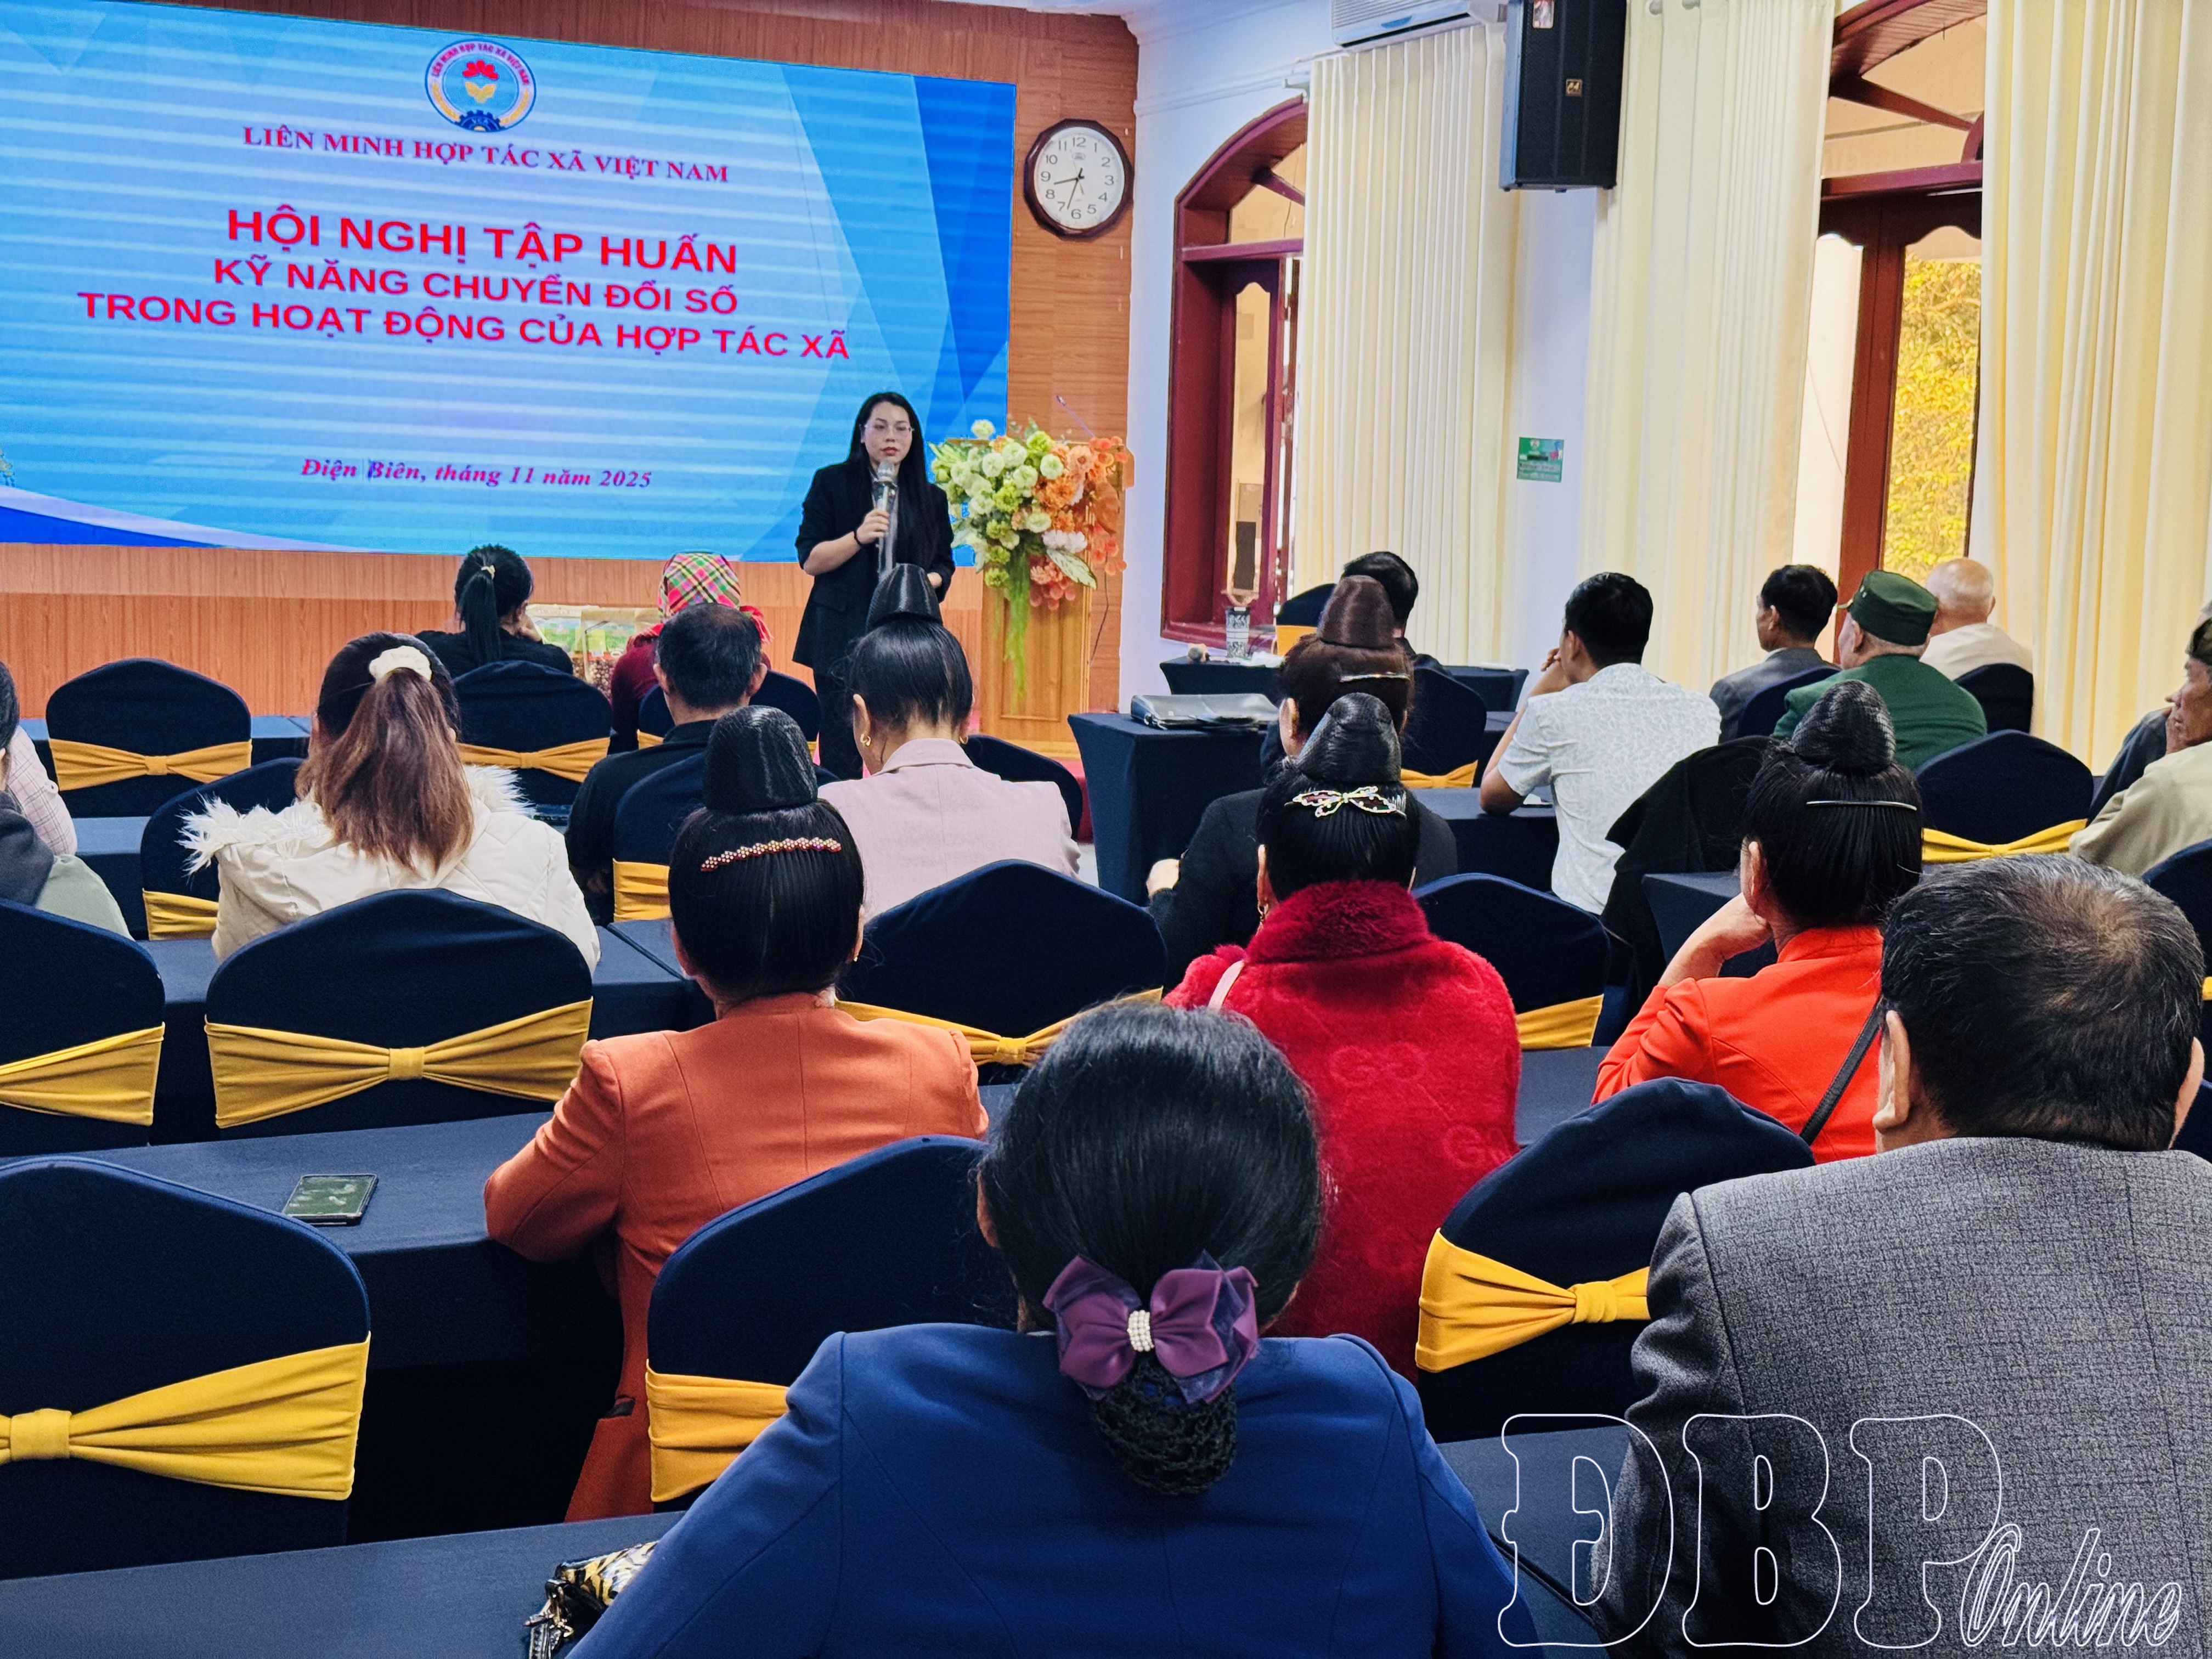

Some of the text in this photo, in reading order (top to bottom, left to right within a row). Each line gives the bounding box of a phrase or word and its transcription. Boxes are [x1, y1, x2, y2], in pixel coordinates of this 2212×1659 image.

[1058, 140, 1067, 151] 11
[1073, 137, 1086, 148] 12
[1094, 143, 1098, 153] 1
[243, 125, 729, 183] LIÊN MINH HỢP TÁC XÃ VIỆT NAM
[1046, 154, 1058, 165] 10
[1101, 157, 1111, 168] 2
[1040, 171, 1051, 182] 9
[1104, 175, 1114, 186] 3
[1045, 189, 1056, 200] 8
[1098, 192, 1108, 202] 4
[1057, 201, 1065, 212] 7
[1087, 204, 1097, 215] 5
[1071, 208, 1081, 219] 6
[228, 203, 737, 274] HỘI NGHỊ TẬP HUẤN
[214, 255, 272, 286] KỸ
[287, 258, 409, 295] NĂNG
[685, 285, 738, 315] SỐ
[77, 292, 850, 360] TRONG HOẠT ĐỘNG CỦA HỢP TÁC XÃ
[300, 459, 653, 489] Điện Biên, tháng 11 năm 2025
